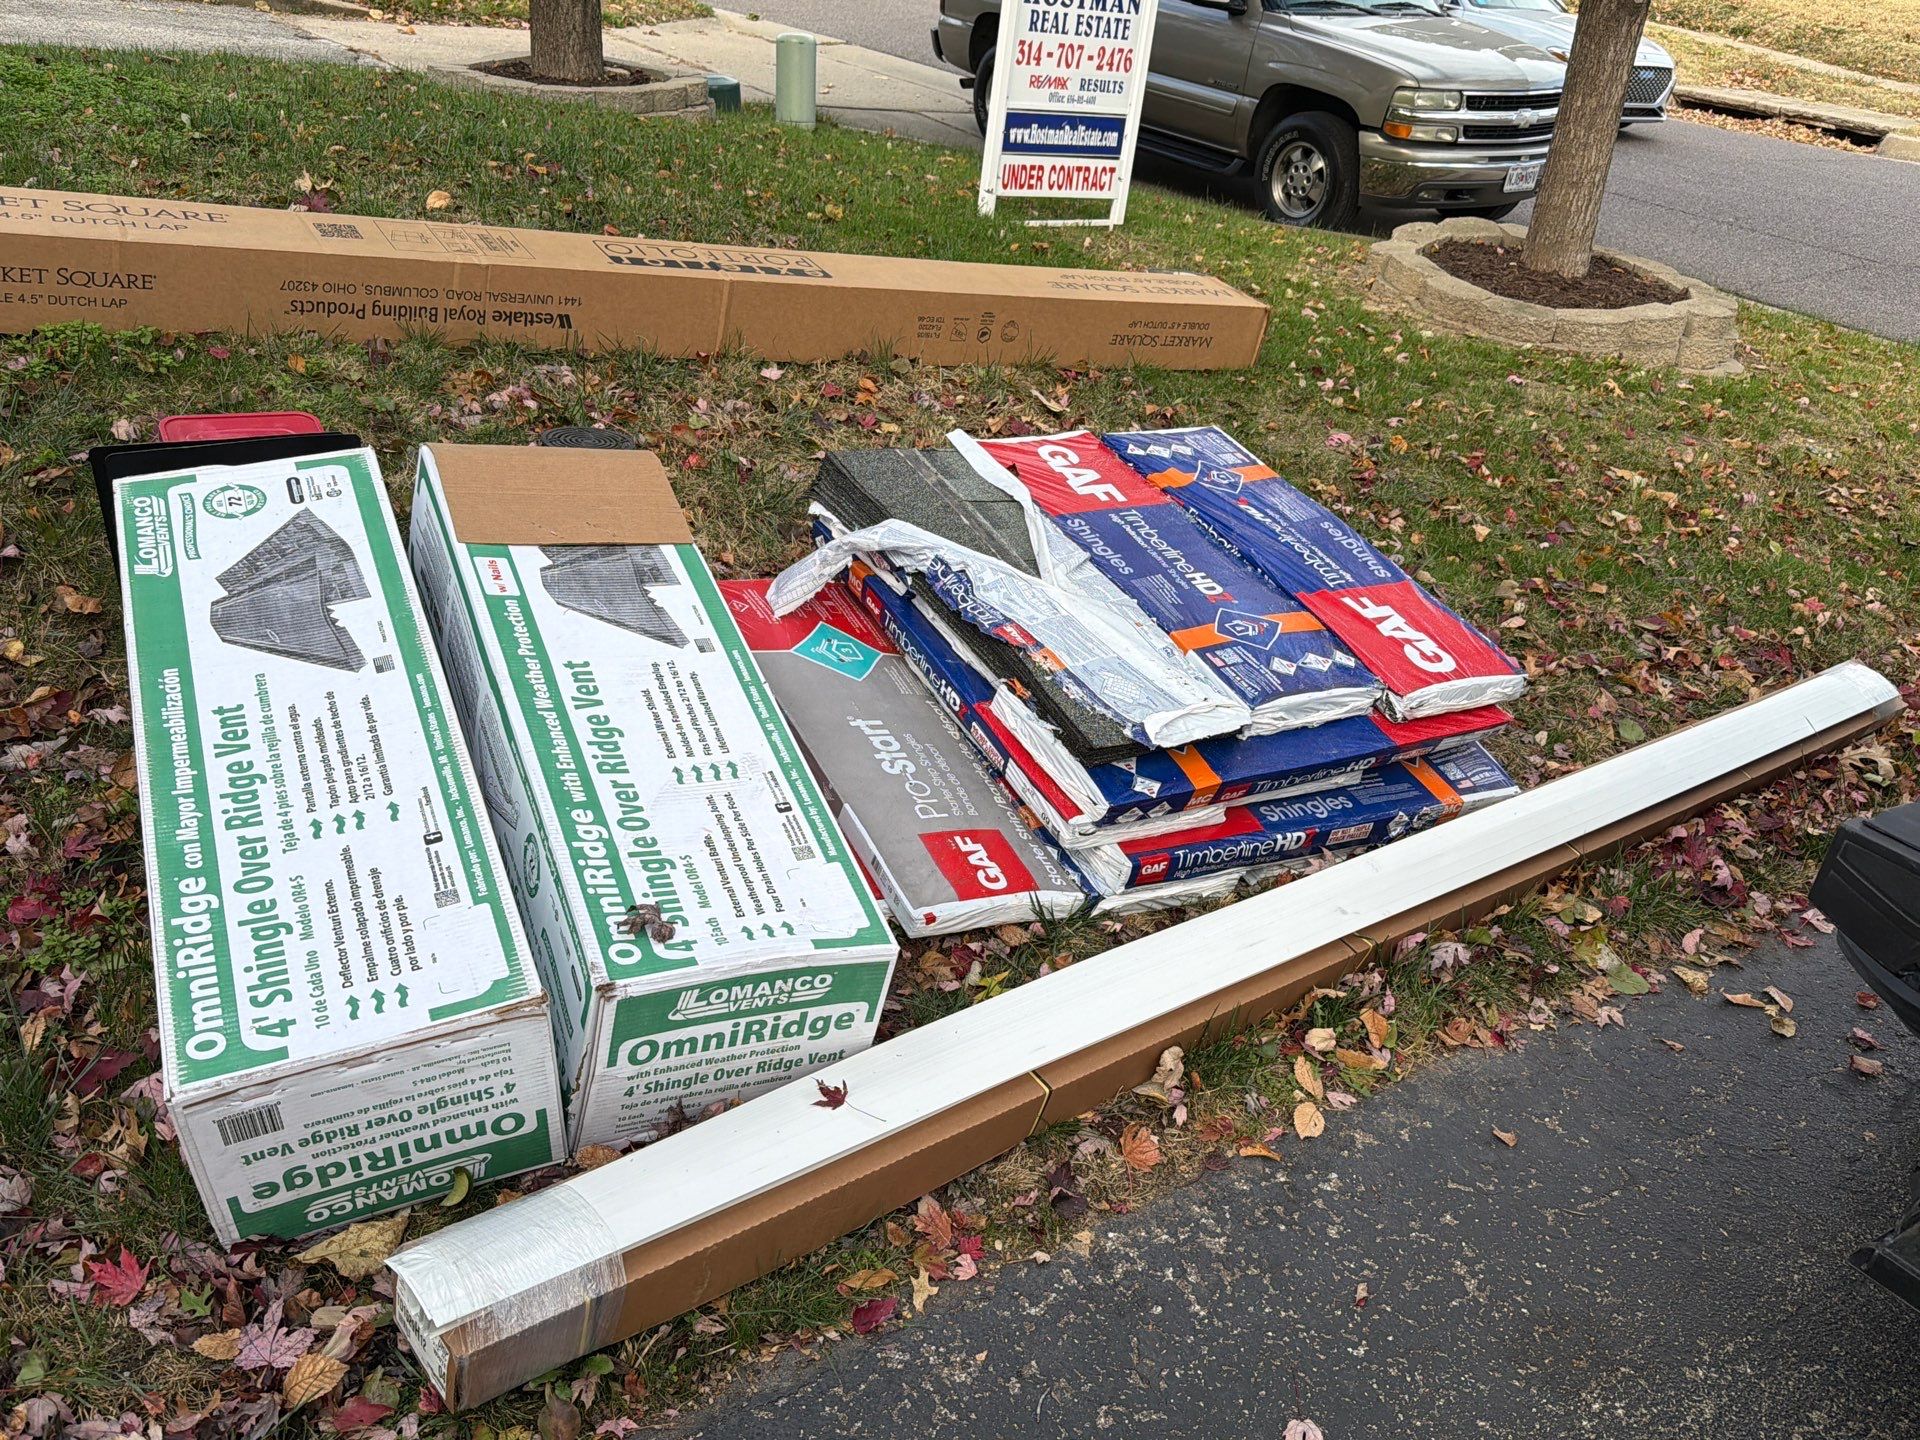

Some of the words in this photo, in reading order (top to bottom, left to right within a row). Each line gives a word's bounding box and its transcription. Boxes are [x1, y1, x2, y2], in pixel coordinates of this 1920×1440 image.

[1028, 9, 1069, 35] REAL
[1074, 14, 1131, 40] ESTATE
[1029, 75, 1070, 90] RE/MAX
[1079, 78, 1124, 94] RESULTS
[1010, 124, 1118, 147] www.HostmanRealEstate.com
[1002, 164, 1044, 190] UNDER
[1048, 165, 1116, 191] CONTRACT
[52, 216, 136, 227] DUTCH
[63, 201, 227, 223] SQUARE
[604, 243, 813, 267] PORTFOLIO
[57, 268, 153, 290] SQUARE
[280, 280, 318, 292] 43207
[322, 282, 356, 294] OHIO
[362, 284, 438, 298] COLUMBUS,
[48, 295, 97, 307] DUTCH
[102, 298, 127, 308] LAP
[443, 289, 481, 301] ROAD,
[485, 292, 553, 304] UNIVERSAL
[559, 296, 582, 306] 1441
[291, 300, 365, 319] Products
[372, 302, 438, 322] Building
[444, 306, 485, 325] Royal
[492, 310, 572, 330] Westlake
[1142, 321, 1168, 329] DUTCH
[1109, 334, 1159, 347] SQUARE
[1160, 336, 1212, 348] MARKET
[1038, 445, 1127, 502] GAF
[228, 497, 242, 506] 72
[152, 514, 168, 546] VENTS
[1067, 519, 1133, 574] Shingles
[1320, 522, 1391, 577] Shingles
[488, 560, 503, 580] Nails
[504, 600, 536, 655] Protection
[1341, 597, 1457, 673] GAF
[255, 673, 271, 712] cumbrera
[525, 658, 554, 708] Weather
[563, 661, 604, 710] Vent
[641, 688, 657, 710] Shield.
[158, 668, 197, 794] Impermeabilización
[212, 704, 251, 758] Vent
[259, 714, 274, 725] de
[652, 711, 665, 730] Water
[261, 726, 282, 752] rejilla
[538, 711, 576, 769] Enhanced
[586, 715, 630, 774] Ridge
[658, 731, 676, 758] External
[903, 734, 931, 766] Shingles
[920, 744, 950, 771] départ
[270, 763, 286, 788] sobre
[560, 773, 587, 802] with
[928, 768, 945, 786] Strip
[947, 773, 960, 785] de
[220, 760, 267, 830] Ridge
[274, 790, 294, 809] pies
[610, 780, 650, 831] Over
[940, 788, 963, 816] Starter
[956, 787, 978, 815] Bande
[176, 797, 203, 840] Mayor
[1260, 797, 1353, 821] Shingles
[278, 818, 294, 830] de
[184, 843, 202, 868] con
[280, 832, 300, 854] Teja
[704, 834, 719, 857] Baffle.
[233, 835, 274, 894] Over
[679, 855, 699, 880] OR4-S
[711, 858, 730, 886] Venturi
[954, 836, 1007, 889] GAF
[1028, 843, 1066, 885] Starter
[1142, 862, 1168, 874] GAF
[289, 875, 307, 902] OR4-S
[325, 879, 339, 914] Externo.
[571, 809, 647, 964] OmniRidge
[690, 881, 712, 908] Model
[723, 886, 745, 917] External
[295, 904, 314, 940] Modelo
[329, 914, 345, 947] Venturi
[706, 917, 723, 937] Each
[238, 898, 293, 1008] Shingle
[305, 950, 320, 971] Uno
[171, 877, 226, 1059] OmniRidge
[338, 948, 354, 988] Deflector
[307, 972, 324, 998] Cada
[678, 974, 833, 1010] LOMANCO
[312, 999, 328, 1012] de
[727, 993, 792, 1012] VENTS
[315, 1015, 330, 1029] 10
[628, 1010, 854, 1066] OmniRidge
[643, 1073, 709, 1094] Shingle
[714, 1066, 752, 1081] Over
[756, 1058, 803, 1074] Ridge
[809, 1050, 845, 1065] Vent
[417, 1087, 494, 1114] Shingle
[492, 1098, 518, 1109] with
[365, 1110, 412, 1130] Over
[432, 1105, 489, 1127] Enhanced
[298, 1124, 360, 1147] Ridge
[379, 1122, 430, 1140] Weather
[241, 1143, 295, 1166] Vent
[252, 1112, 527, 1199] OmniRidge
[311, 1137, 376, 1159] Protection
[350, 1170, 424, 1196] VENTS
